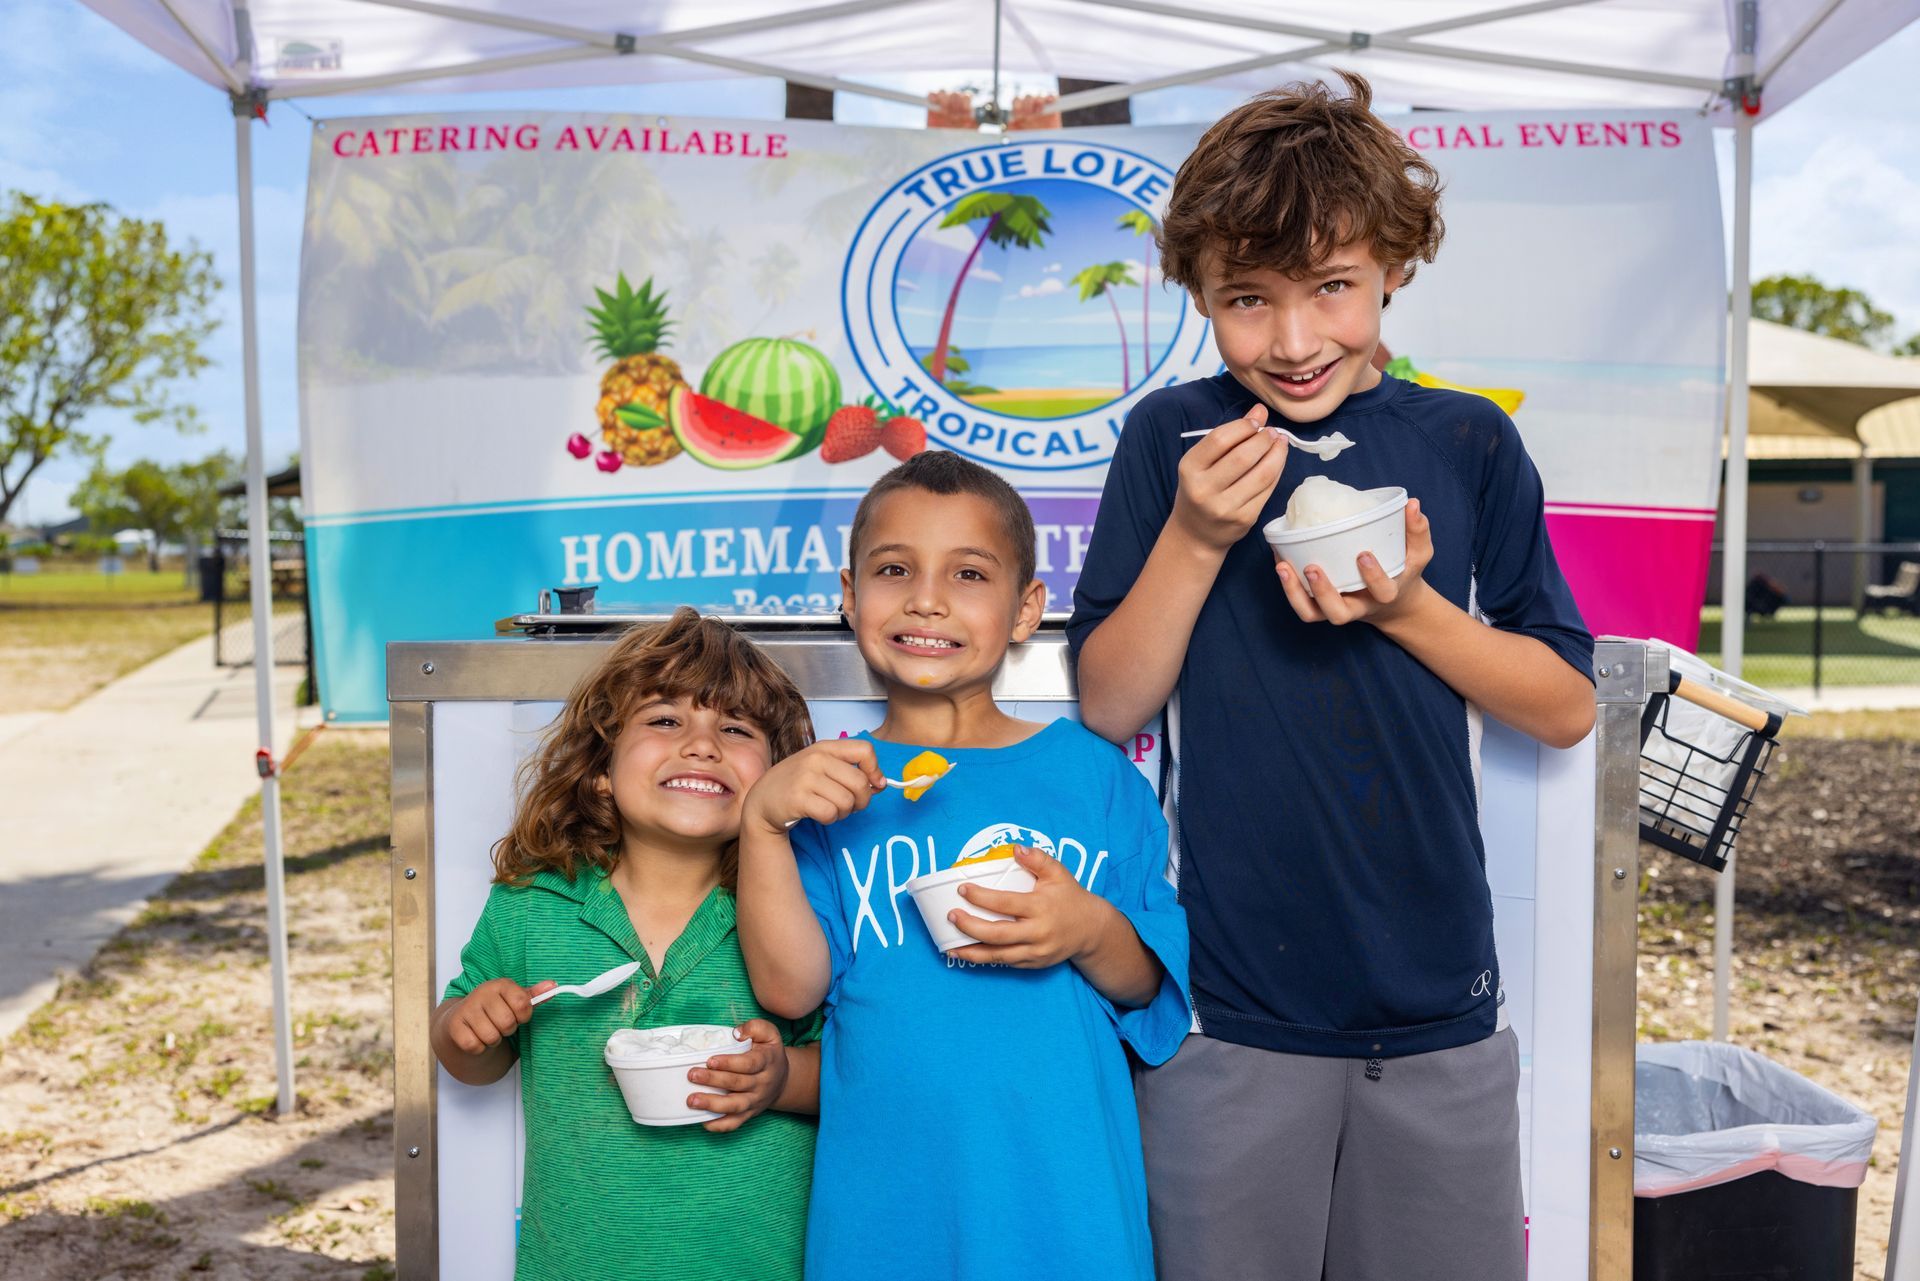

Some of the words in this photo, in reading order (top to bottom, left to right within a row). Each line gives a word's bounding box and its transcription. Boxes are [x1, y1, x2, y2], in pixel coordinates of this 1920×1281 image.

[333, 124, 541, 157] CATERING
[555, 125, 788, 158] AVAILABLE
[1394, 124, 1504, 150] CIAL
[1517, 121, 1683, 148] EVENTS
[904, 150, 1027, 208] TRUE
[1043, 148, 1169, 205] LOVE
[892, 376, 1099, 458] TROPICAL
